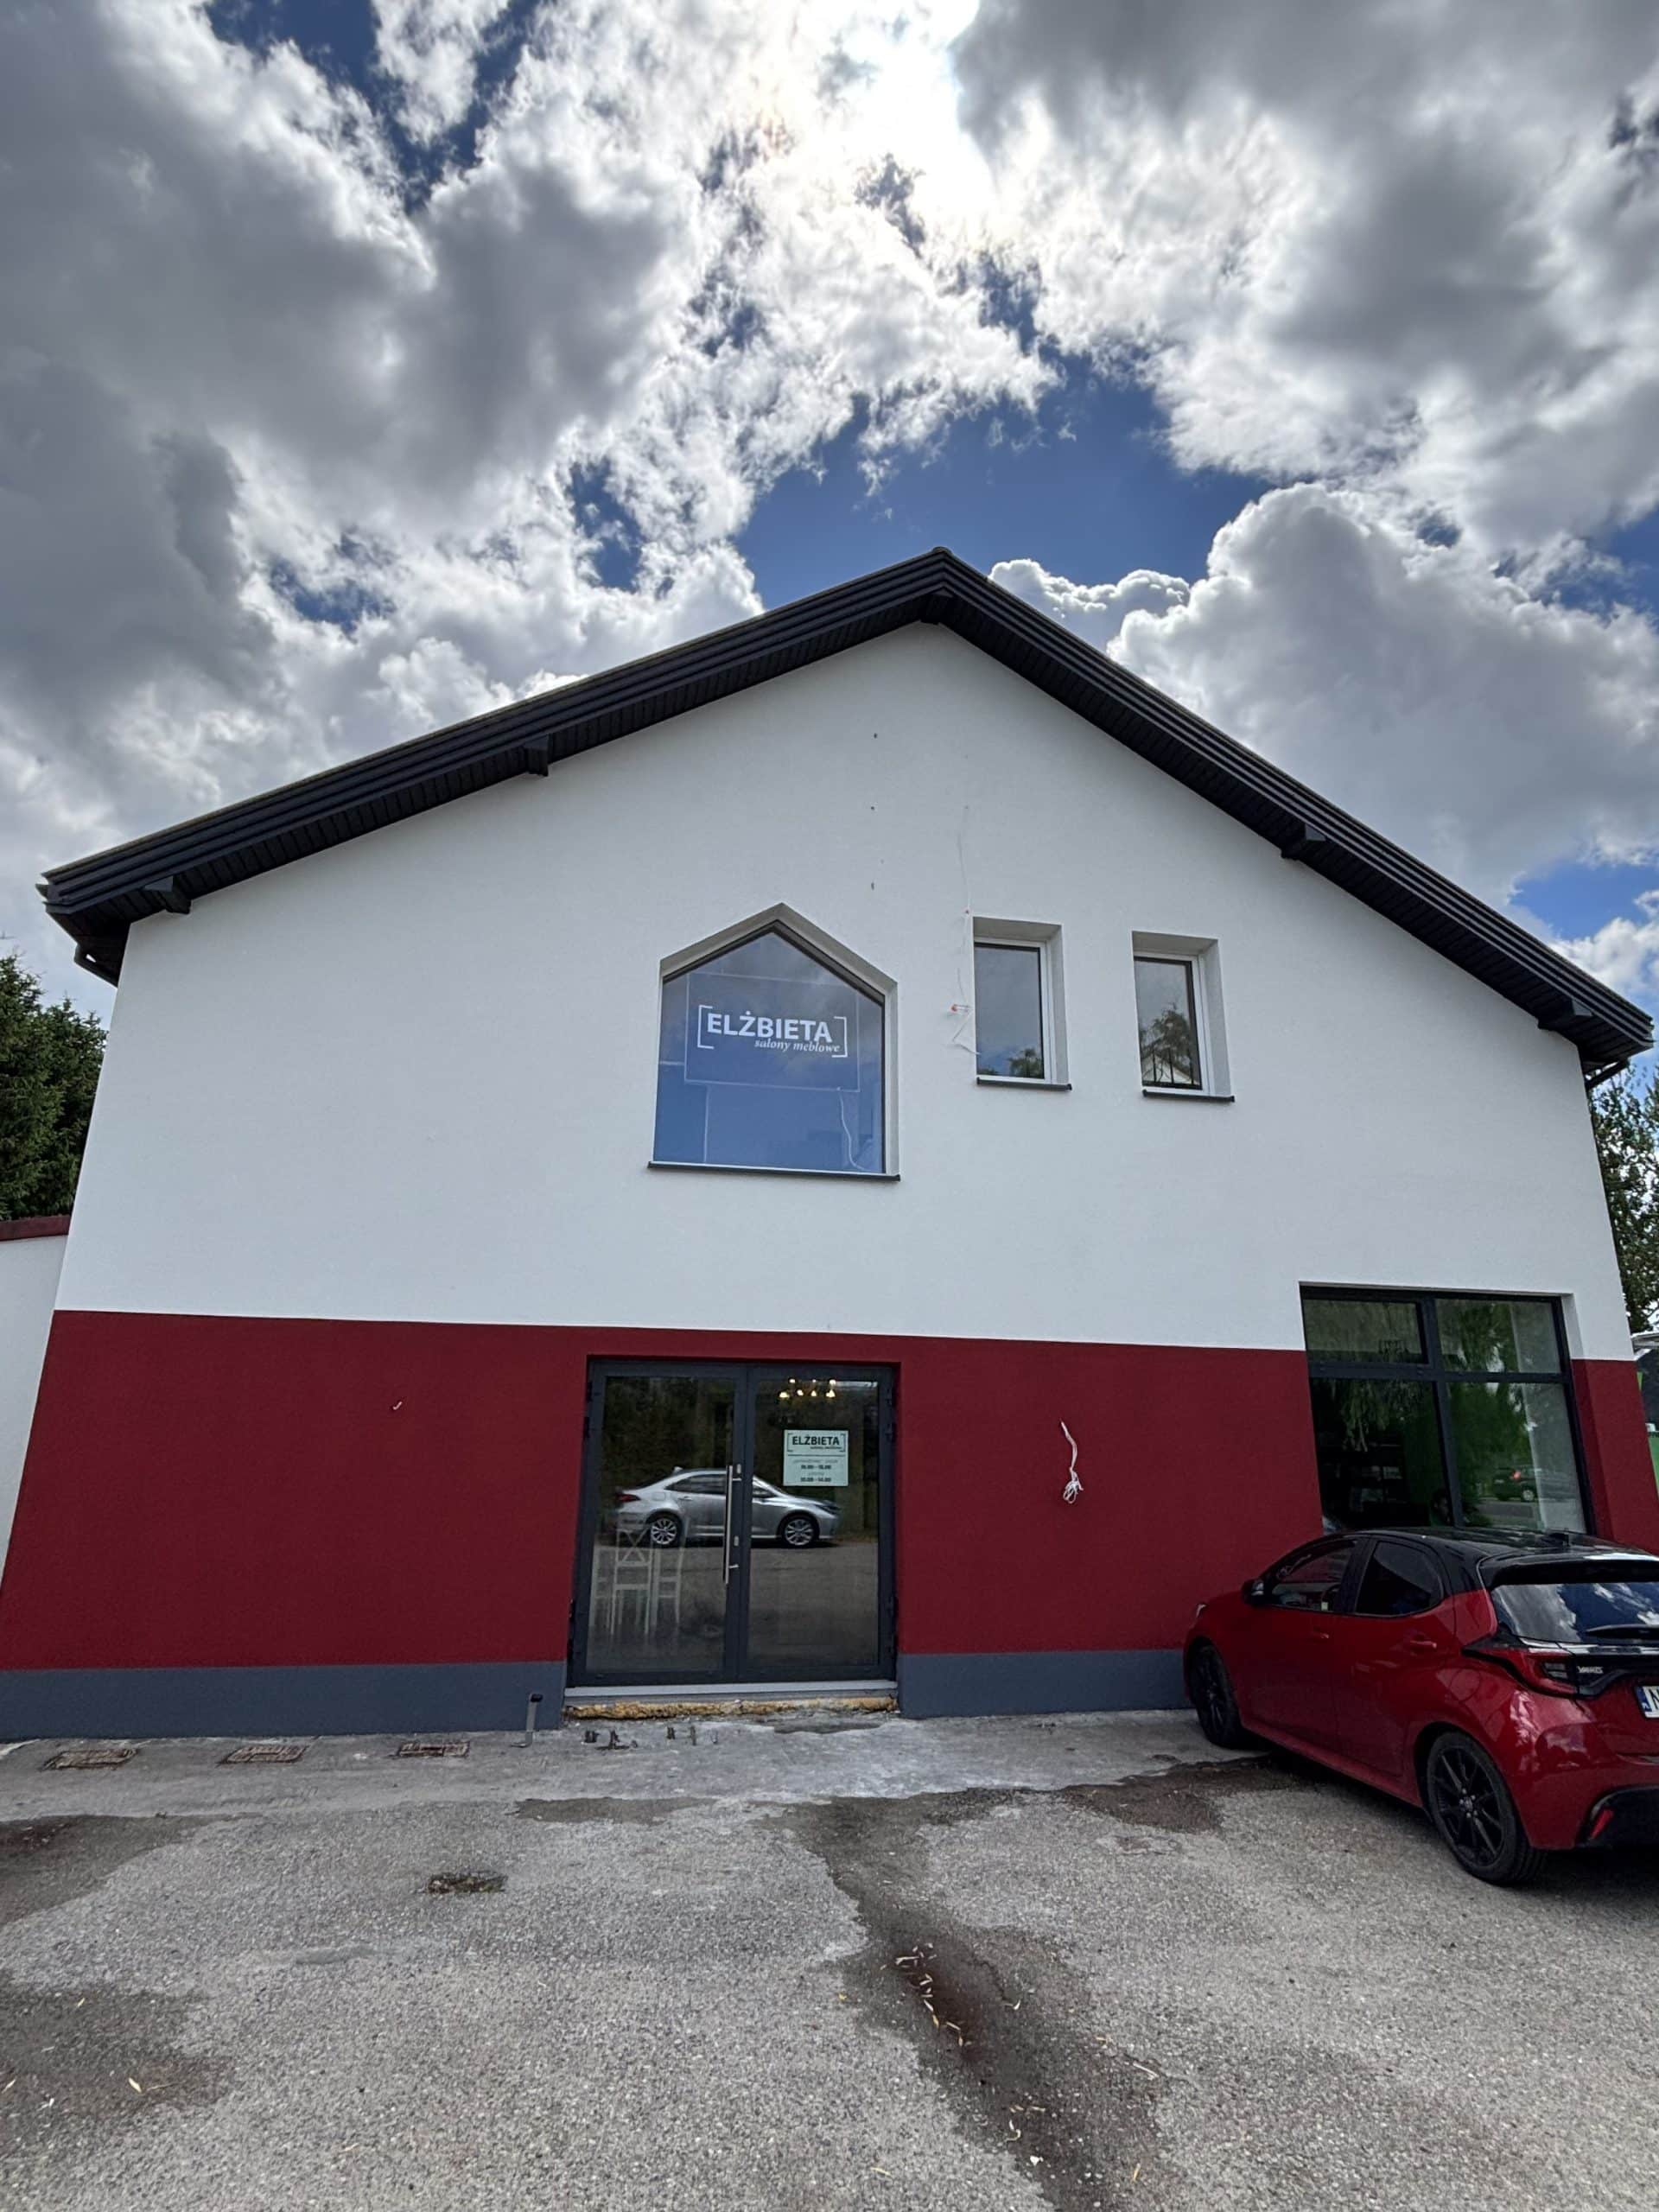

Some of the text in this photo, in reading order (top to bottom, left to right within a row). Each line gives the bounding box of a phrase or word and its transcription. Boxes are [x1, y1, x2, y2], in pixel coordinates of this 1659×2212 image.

[707, 1010, 833, 1043] ELŻBIETA
[754, 1038, 841, 1053] salony meblowe
